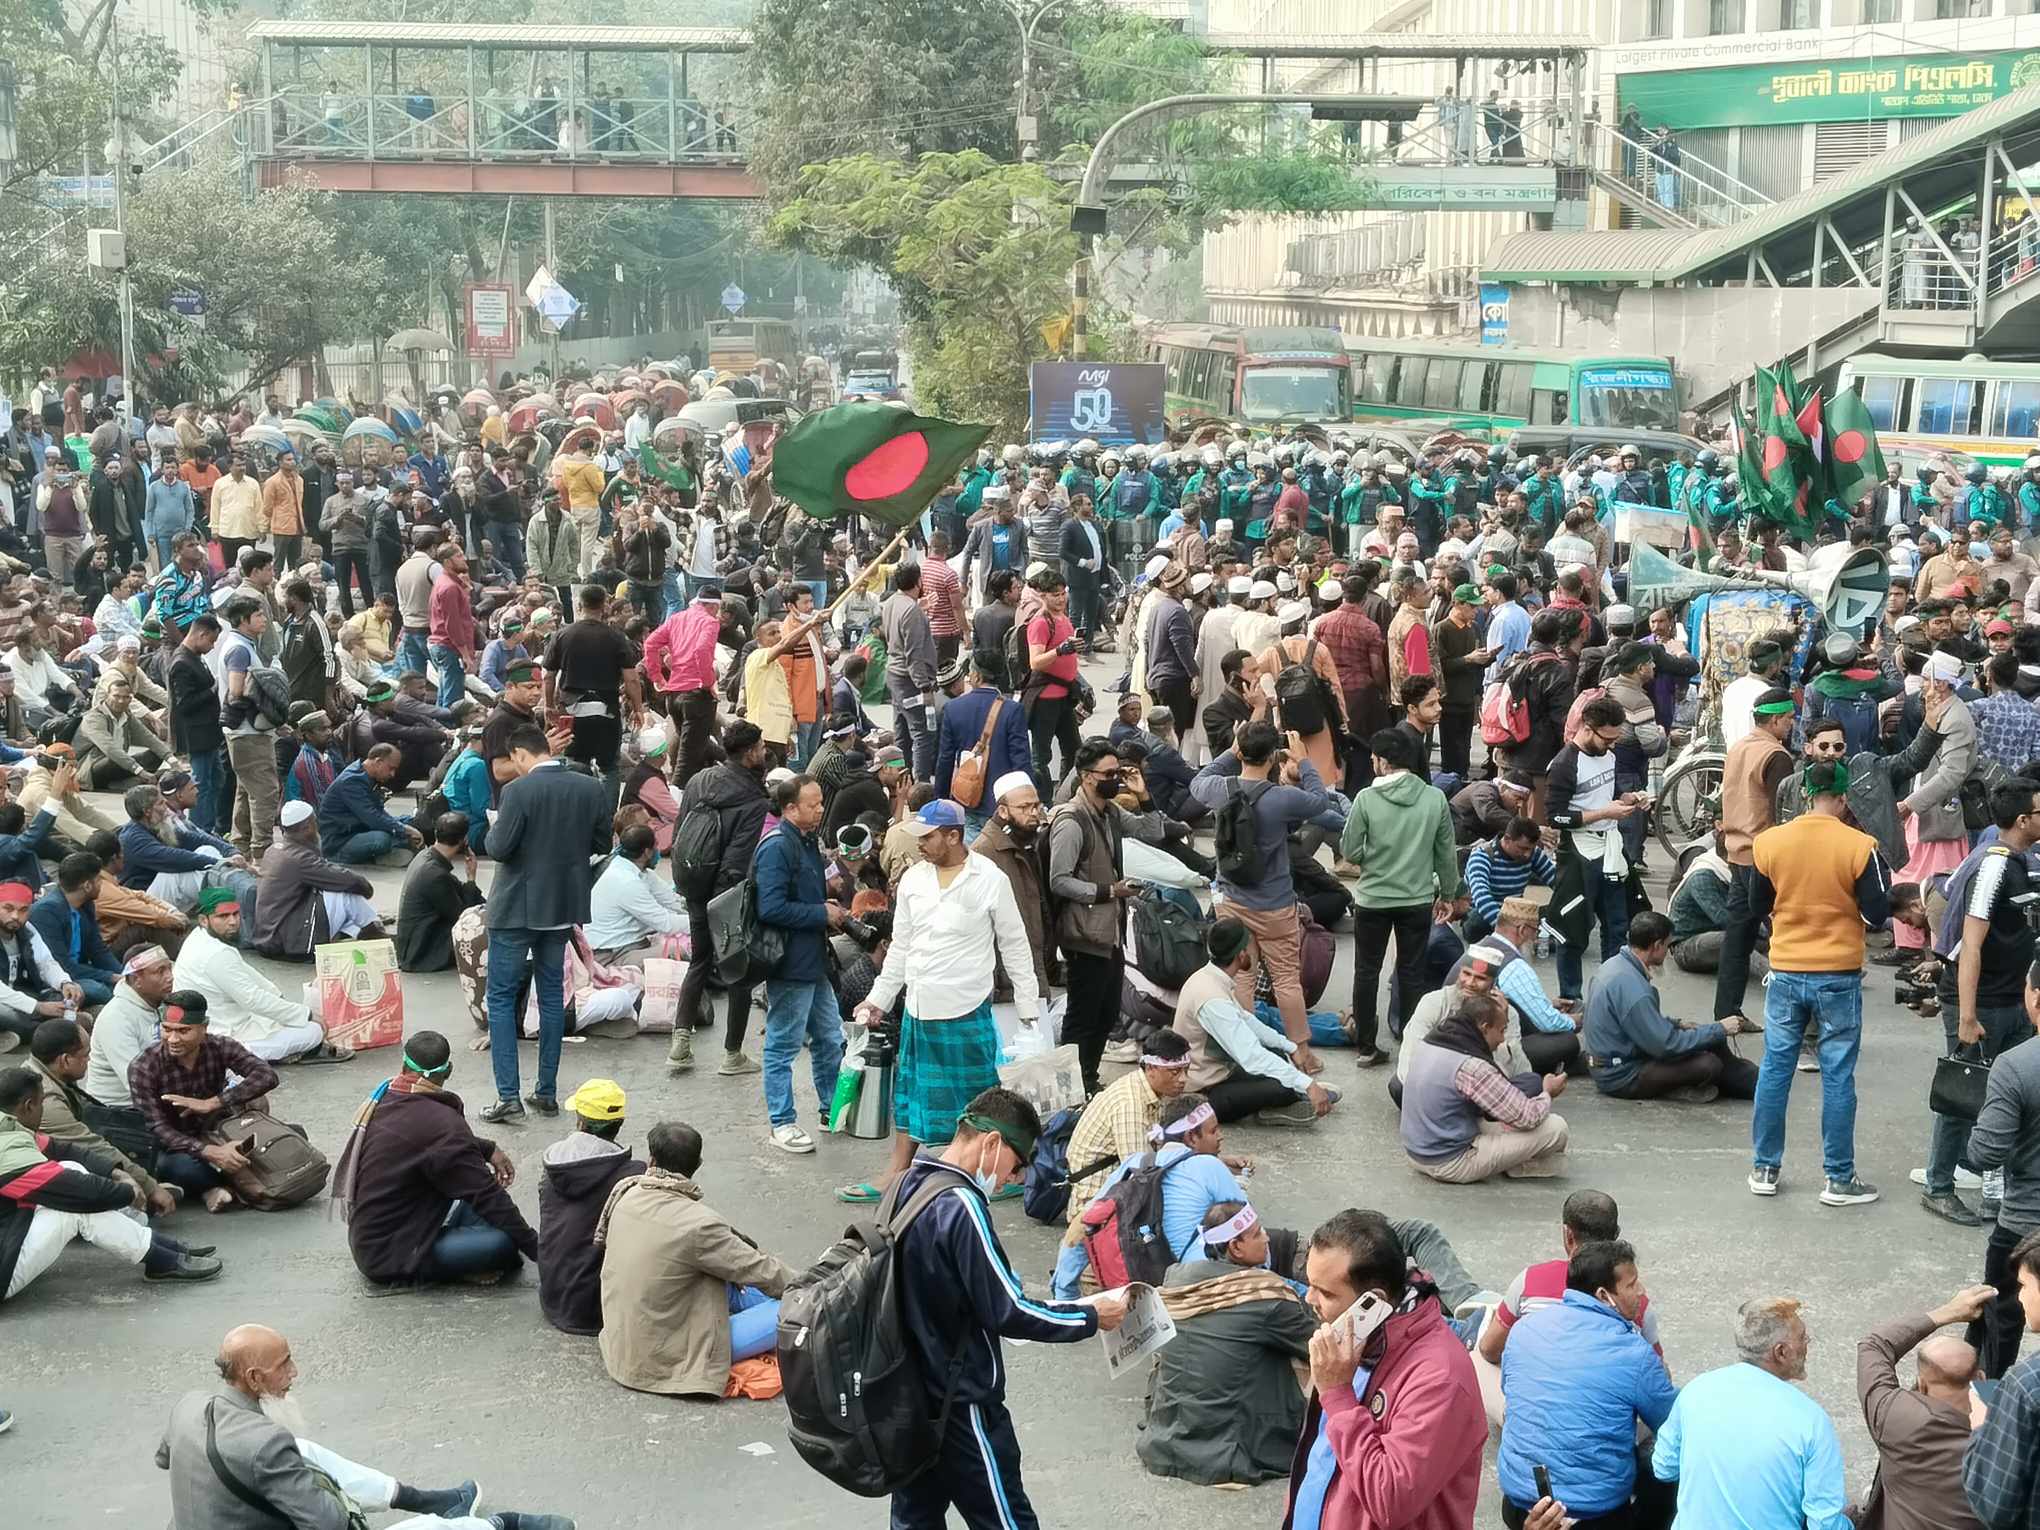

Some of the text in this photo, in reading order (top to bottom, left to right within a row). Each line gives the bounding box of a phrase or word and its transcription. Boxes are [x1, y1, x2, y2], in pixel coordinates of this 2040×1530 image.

[1703, 39, 1782, 56] Commercial
[1786, 38, 1819, 50] Bank
[1070, 387, 1112, 432] 50
